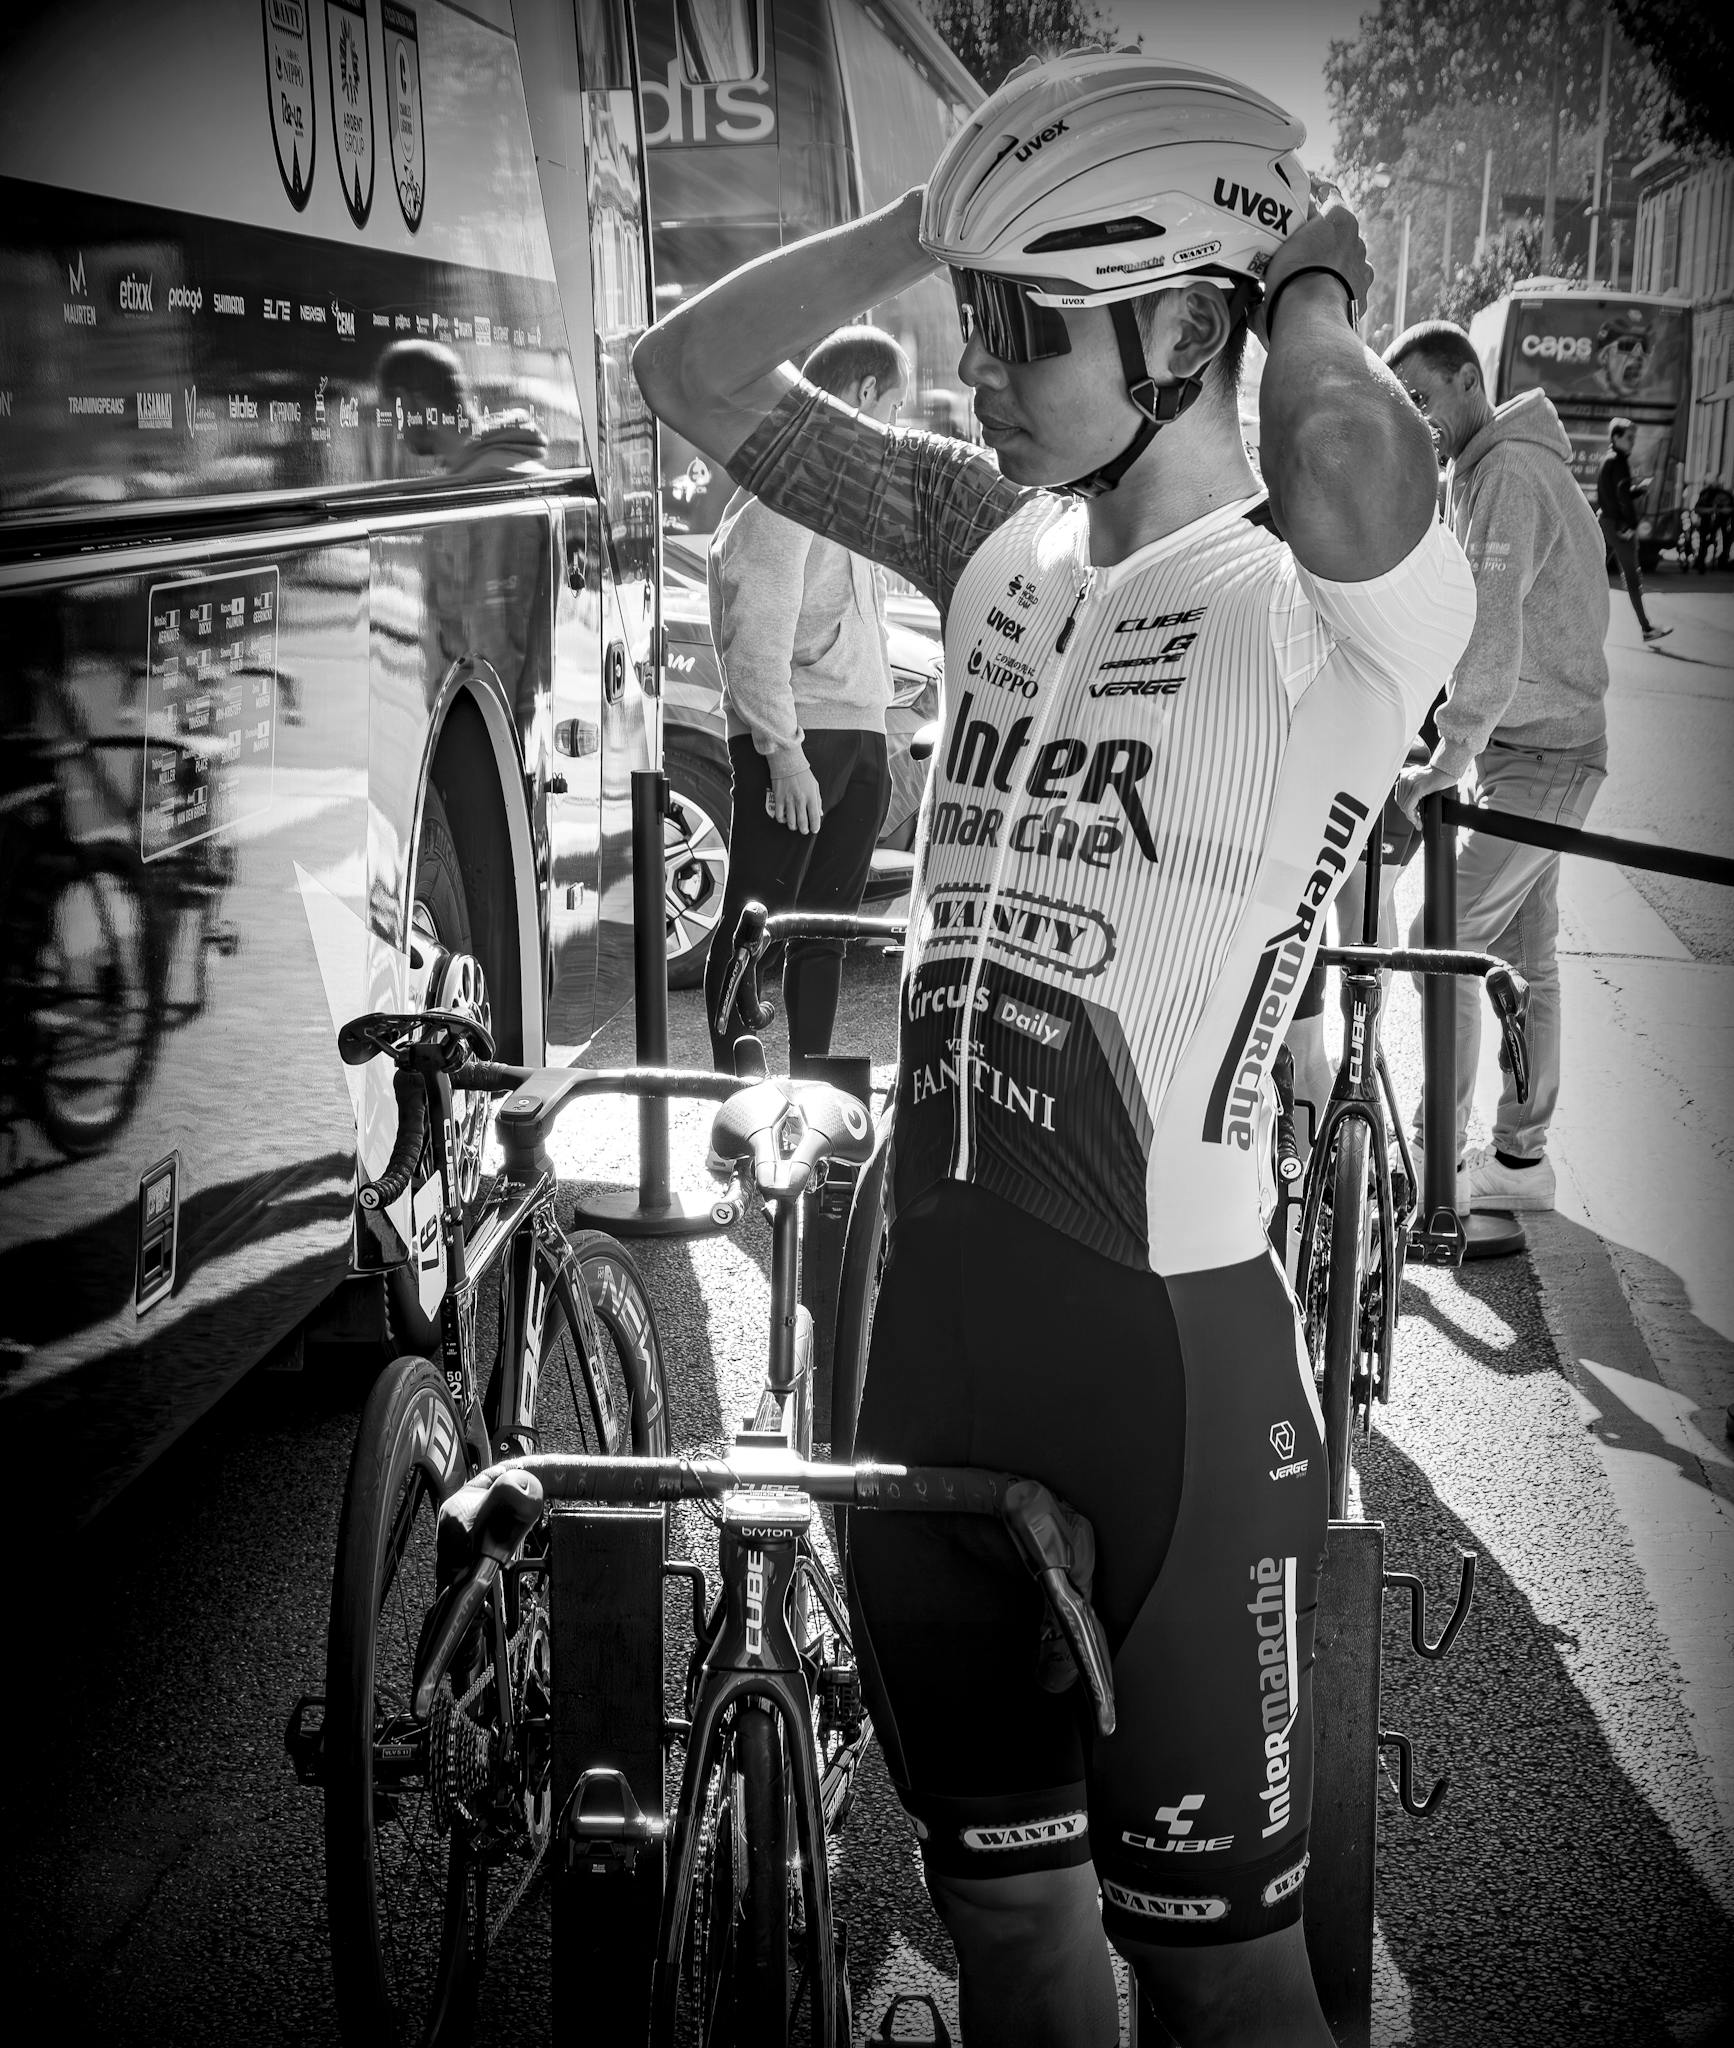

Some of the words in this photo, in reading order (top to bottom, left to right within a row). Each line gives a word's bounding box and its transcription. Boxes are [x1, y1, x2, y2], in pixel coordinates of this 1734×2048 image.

[1014, 119, 1070, 163] uvex
[1213, 176, 1293, 236] uvex
[1179, 244, 1216, 260] WANTY
[63, 303, 97, 326] MAURTEN
[168, 284, 203, 315] prologo
[213, 293, 245, 315] SHIMANO
[336, 311, 355, 336] CEMA
[1061, 297, 1086, 306] uvex
[1522, 334, 1593, 363] caps
[68, 396, 125, 415] TRAININGPEAKS
[1025, 582, 1037, 593] UCI
[986, 605, 1026, 643] uvex
[1114, 606, 1208, 633] CUBE
[980, 659, 1039, 699] NIPPO
[1088, 677, 1187, 698] VERGE
[1000, 1002, 1060, 1045] Daily
[1349, 1000, 1367, 1084] CUBE
[912, 1056, 1056, 1132] FANTINI
[443, 1118, 456, 1209] CUBE
[446, 1370, 462, 1381] 50
[1269, 1459, 1309, 1481] VERGE
[745, 1549, 764, 1655] CUBE
[975, 1817, 1079, 1847] WANTY
[1121, 1830, 1235, 1853] CUBE
[1105, 1879, 1215, 1916] WANTY
